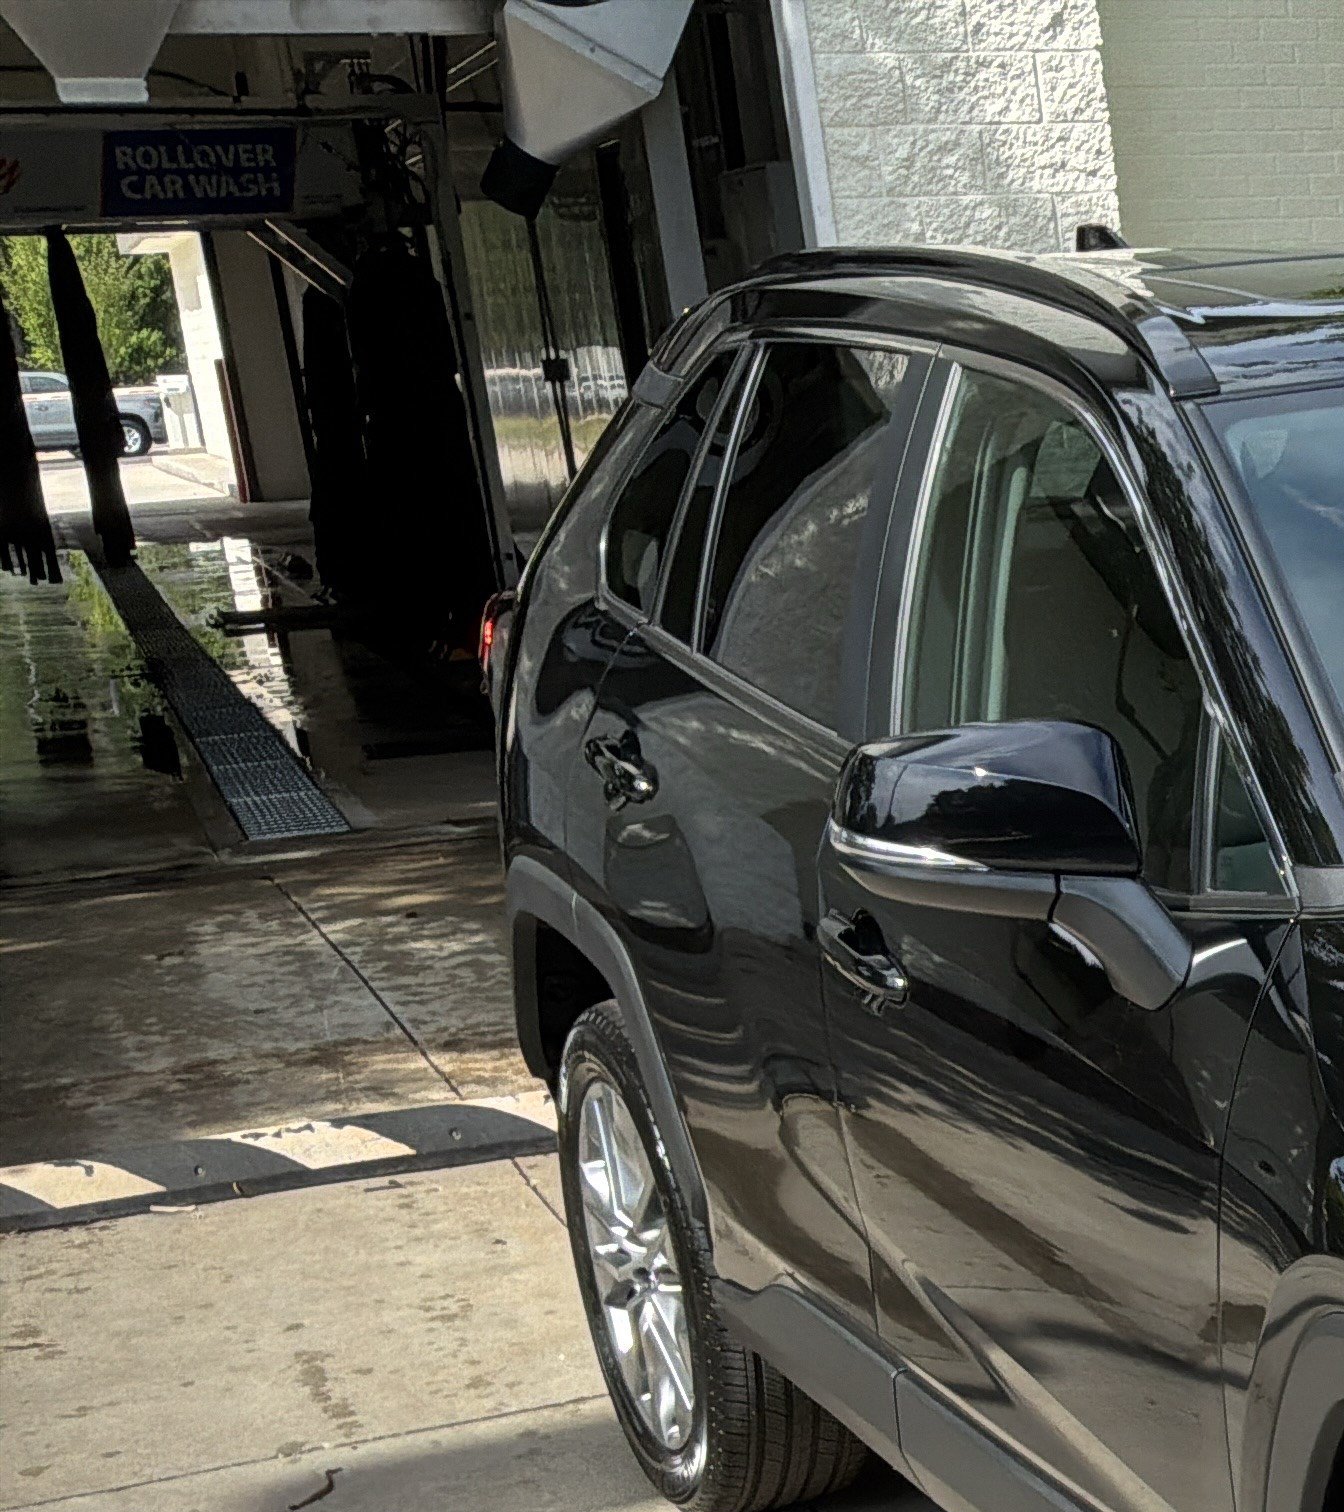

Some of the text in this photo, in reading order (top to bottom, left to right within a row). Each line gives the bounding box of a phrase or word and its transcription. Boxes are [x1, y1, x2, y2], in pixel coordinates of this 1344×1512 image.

[114, 144, 277, 170] ROLLOVER
[120, 173, 281, 200] CAR WASH
